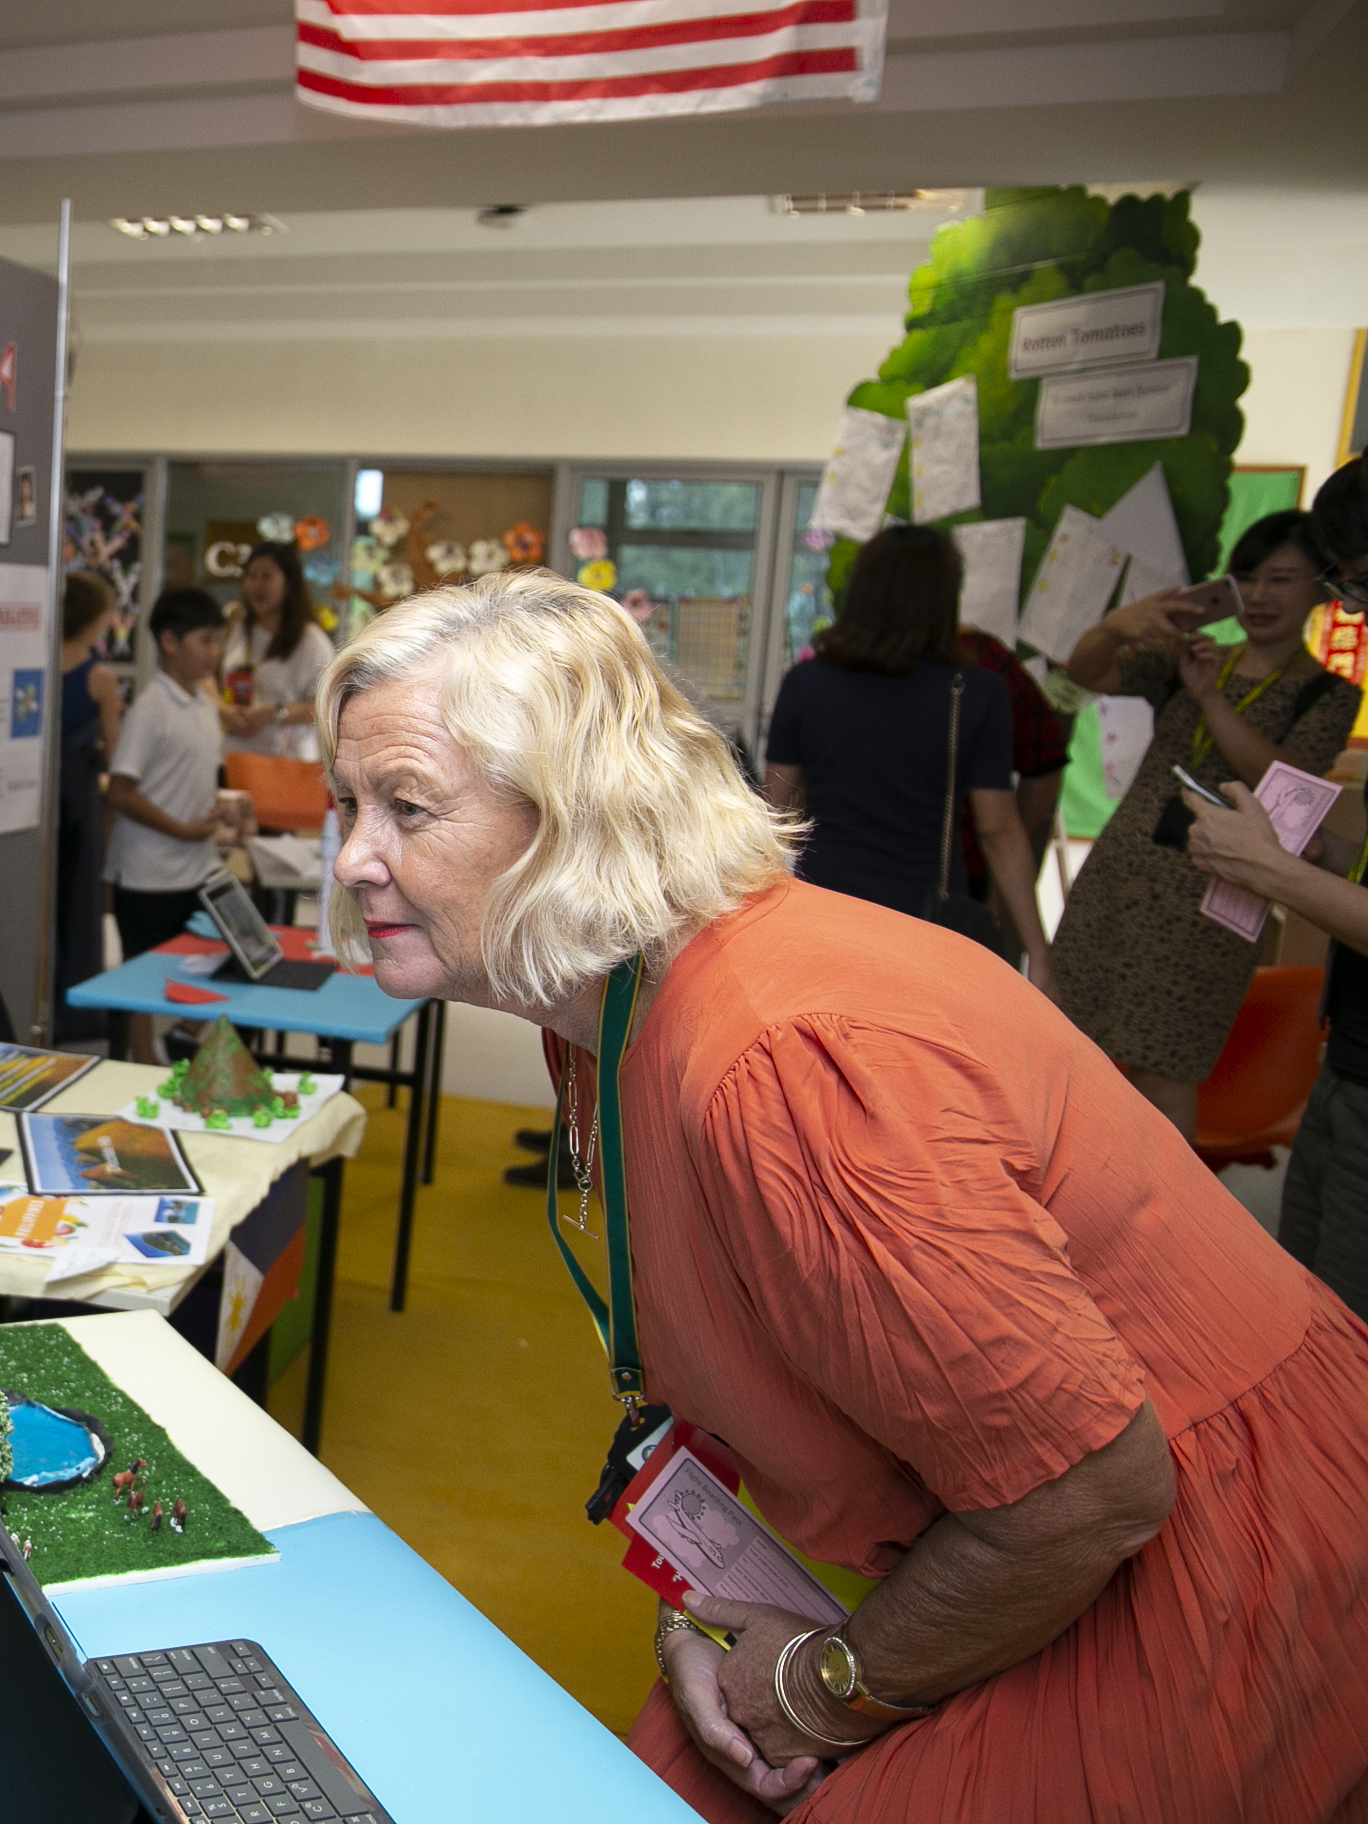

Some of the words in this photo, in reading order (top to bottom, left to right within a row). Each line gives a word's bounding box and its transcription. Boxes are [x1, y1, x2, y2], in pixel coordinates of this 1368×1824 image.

[1070, 320, 1148, 345] Tomatoes
[683, 1466, 703, 1487] Flight
[700, 1483, 730, 1513] Boarding
[726, 1509, 744, 1526] Pass
